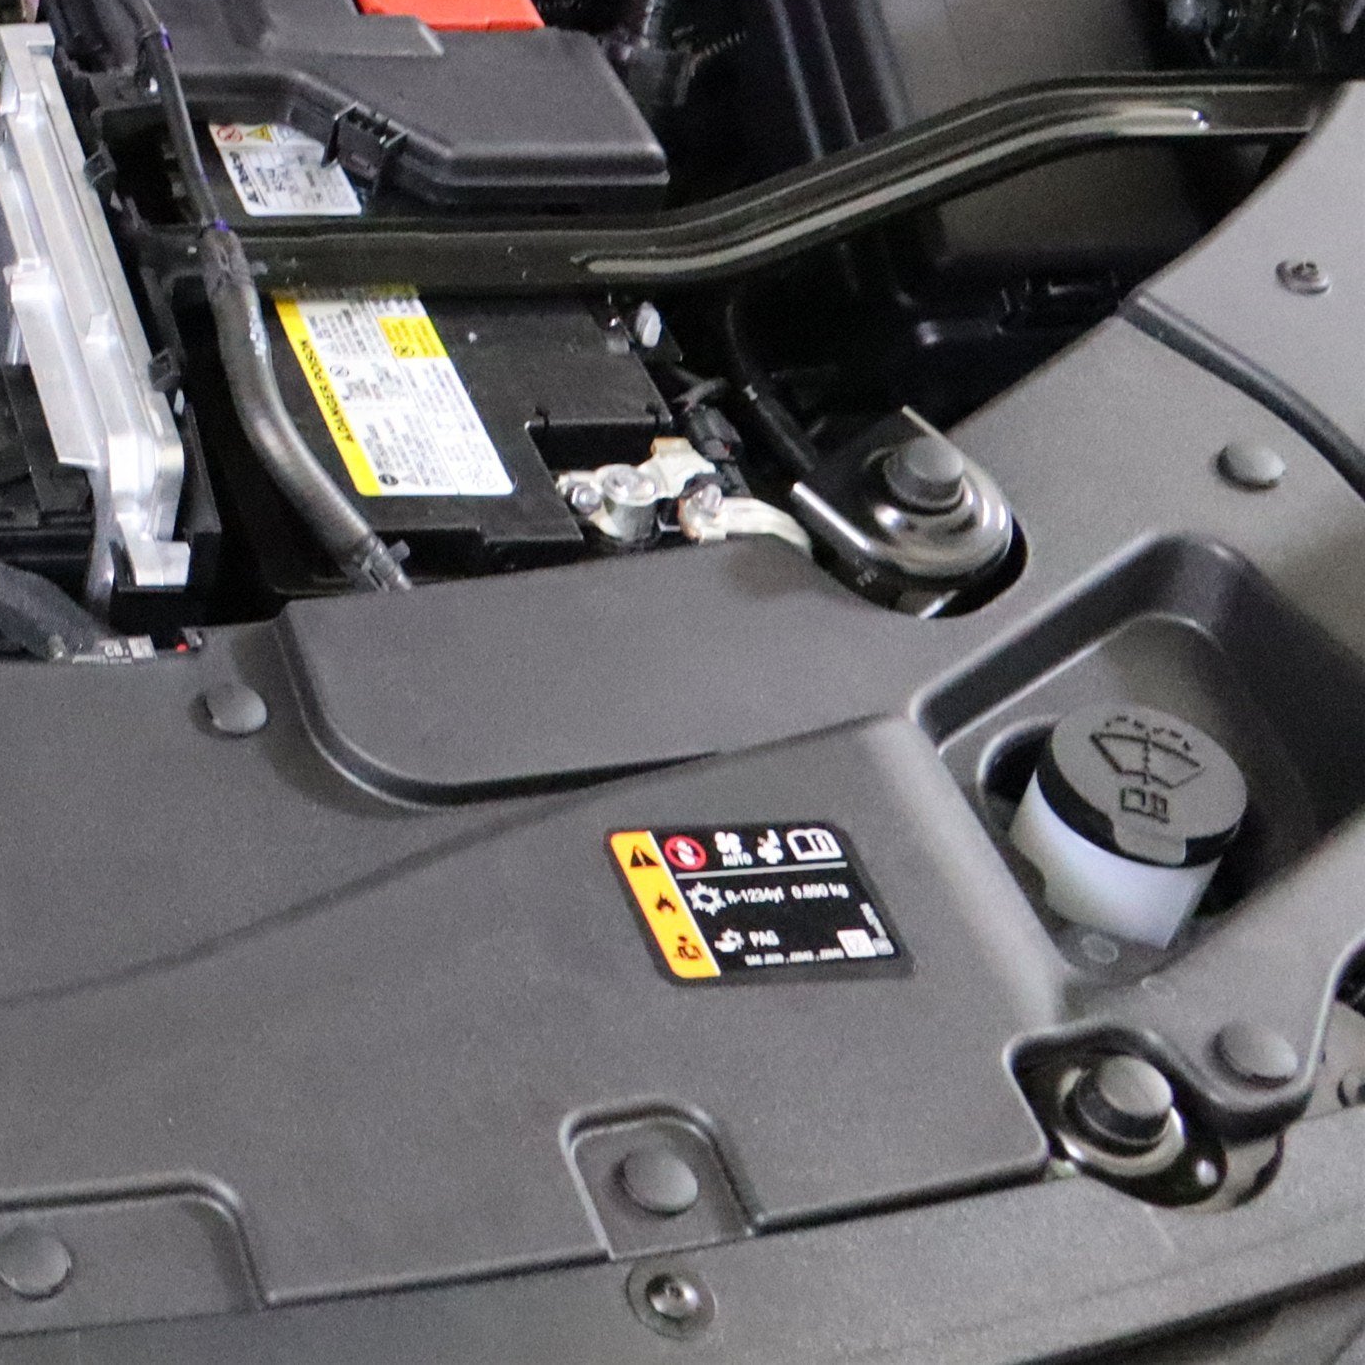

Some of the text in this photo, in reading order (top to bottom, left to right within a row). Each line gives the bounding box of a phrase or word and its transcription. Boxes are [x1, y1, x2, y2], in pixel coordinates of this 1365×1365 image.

[299, 339, 323, 381] POISON
[722, 852, 753, 867] AUTO
[725, 886, 785, 904] R-1234yf
[829, 882, 849, 899] kg
[749, 930, 780, 947] PAG
